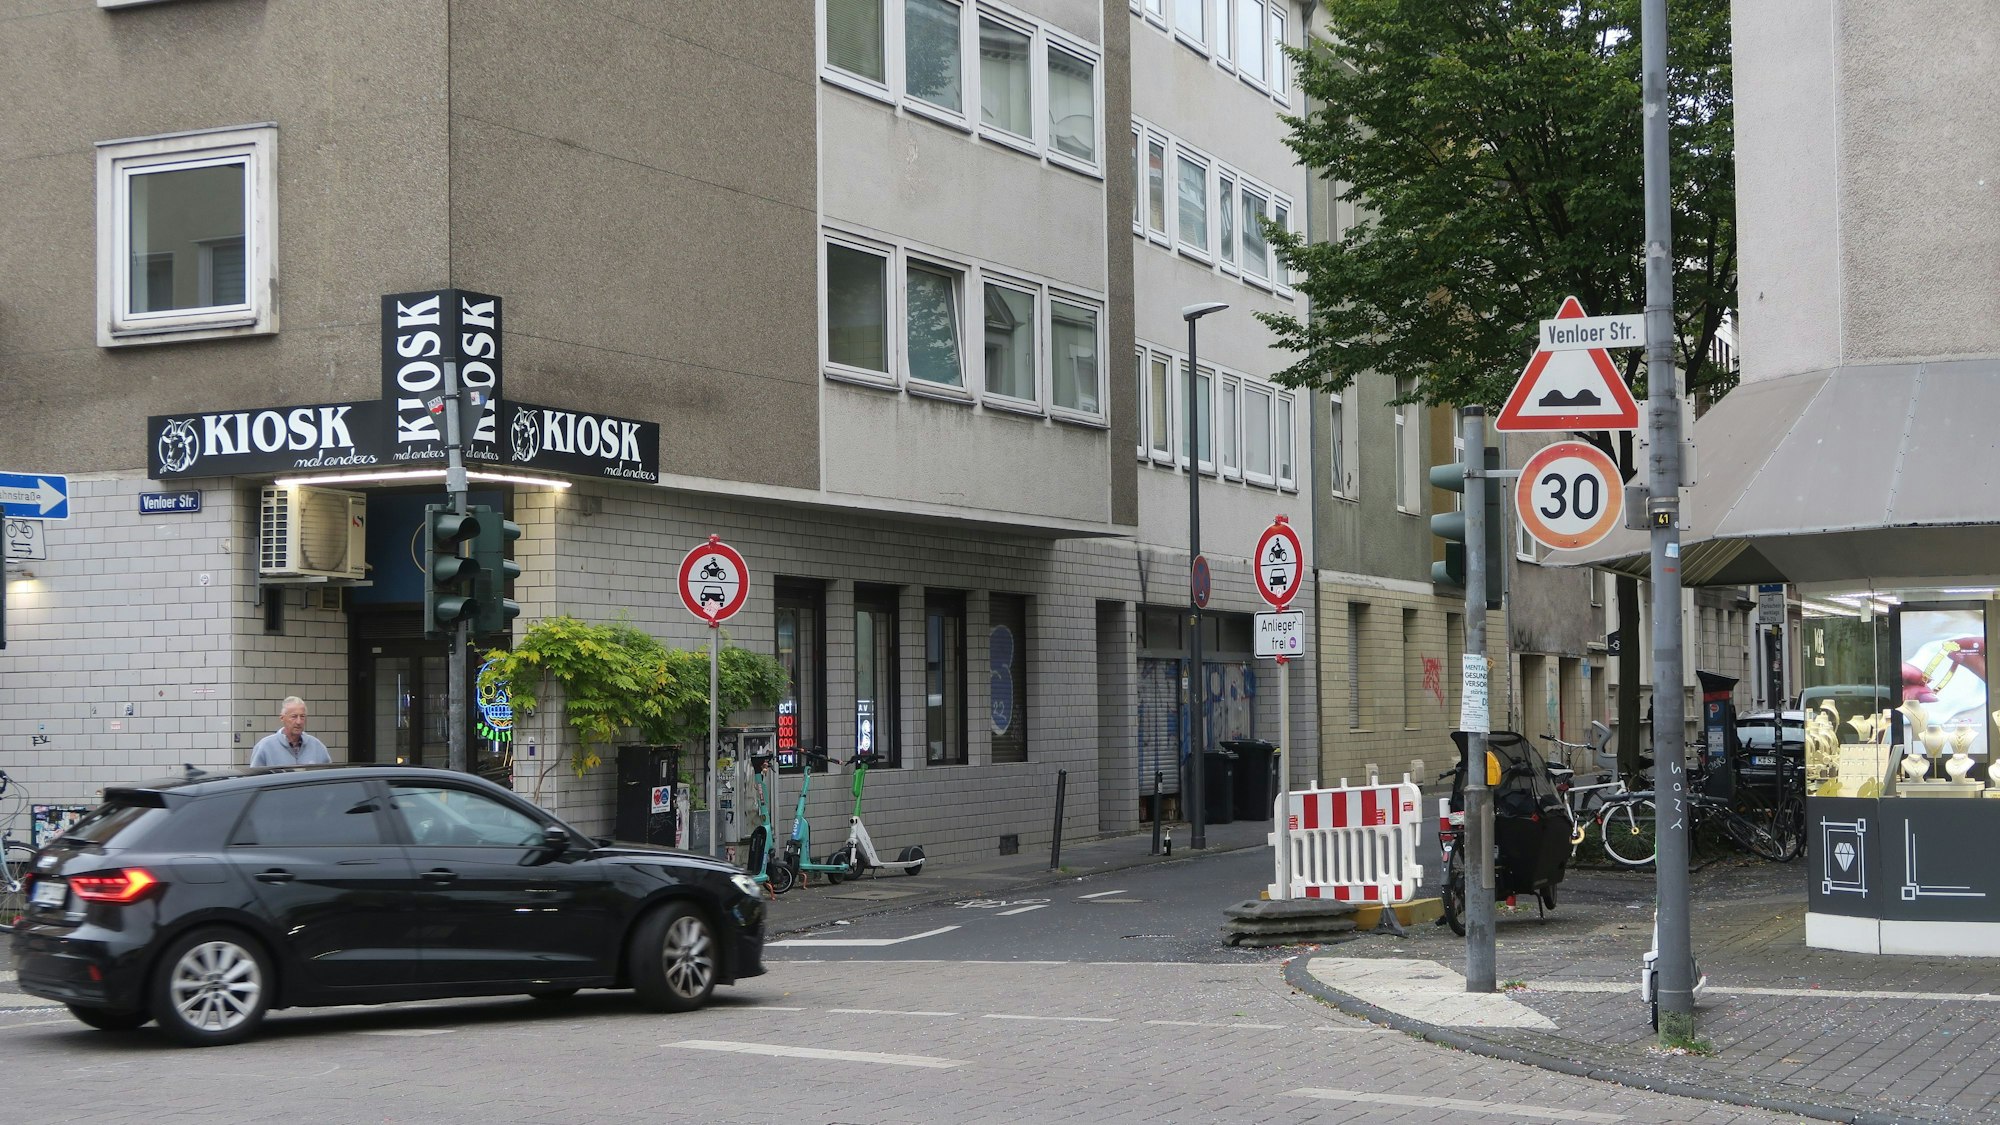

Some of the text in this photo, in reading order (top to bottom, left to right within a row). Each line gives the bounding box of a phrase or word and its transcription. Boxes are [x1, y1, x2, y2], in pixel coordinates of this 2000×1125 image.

[1548, 321, 1636, 344] Venloer Str.
[396, 295, 441, 443] KIOSK
[202, 406, 355, 456] KIOSK
[542, 409, 641, 462] KIOSK
[293, 447, 378, 468] mal anders
[393, 444, 446, 460] mal anders
[604, 461, 656, 480] mal anders
[143, 494, 197, 510] Venloer Str.
[1540, 472, 1599, 520] 30
[1658, 513, 1669, 524] 41
[1261, 619, 1296, 634] Anlieger
[1272, 637, 1286, 649] frei
[1671, 762, 1682, 829] SONY
